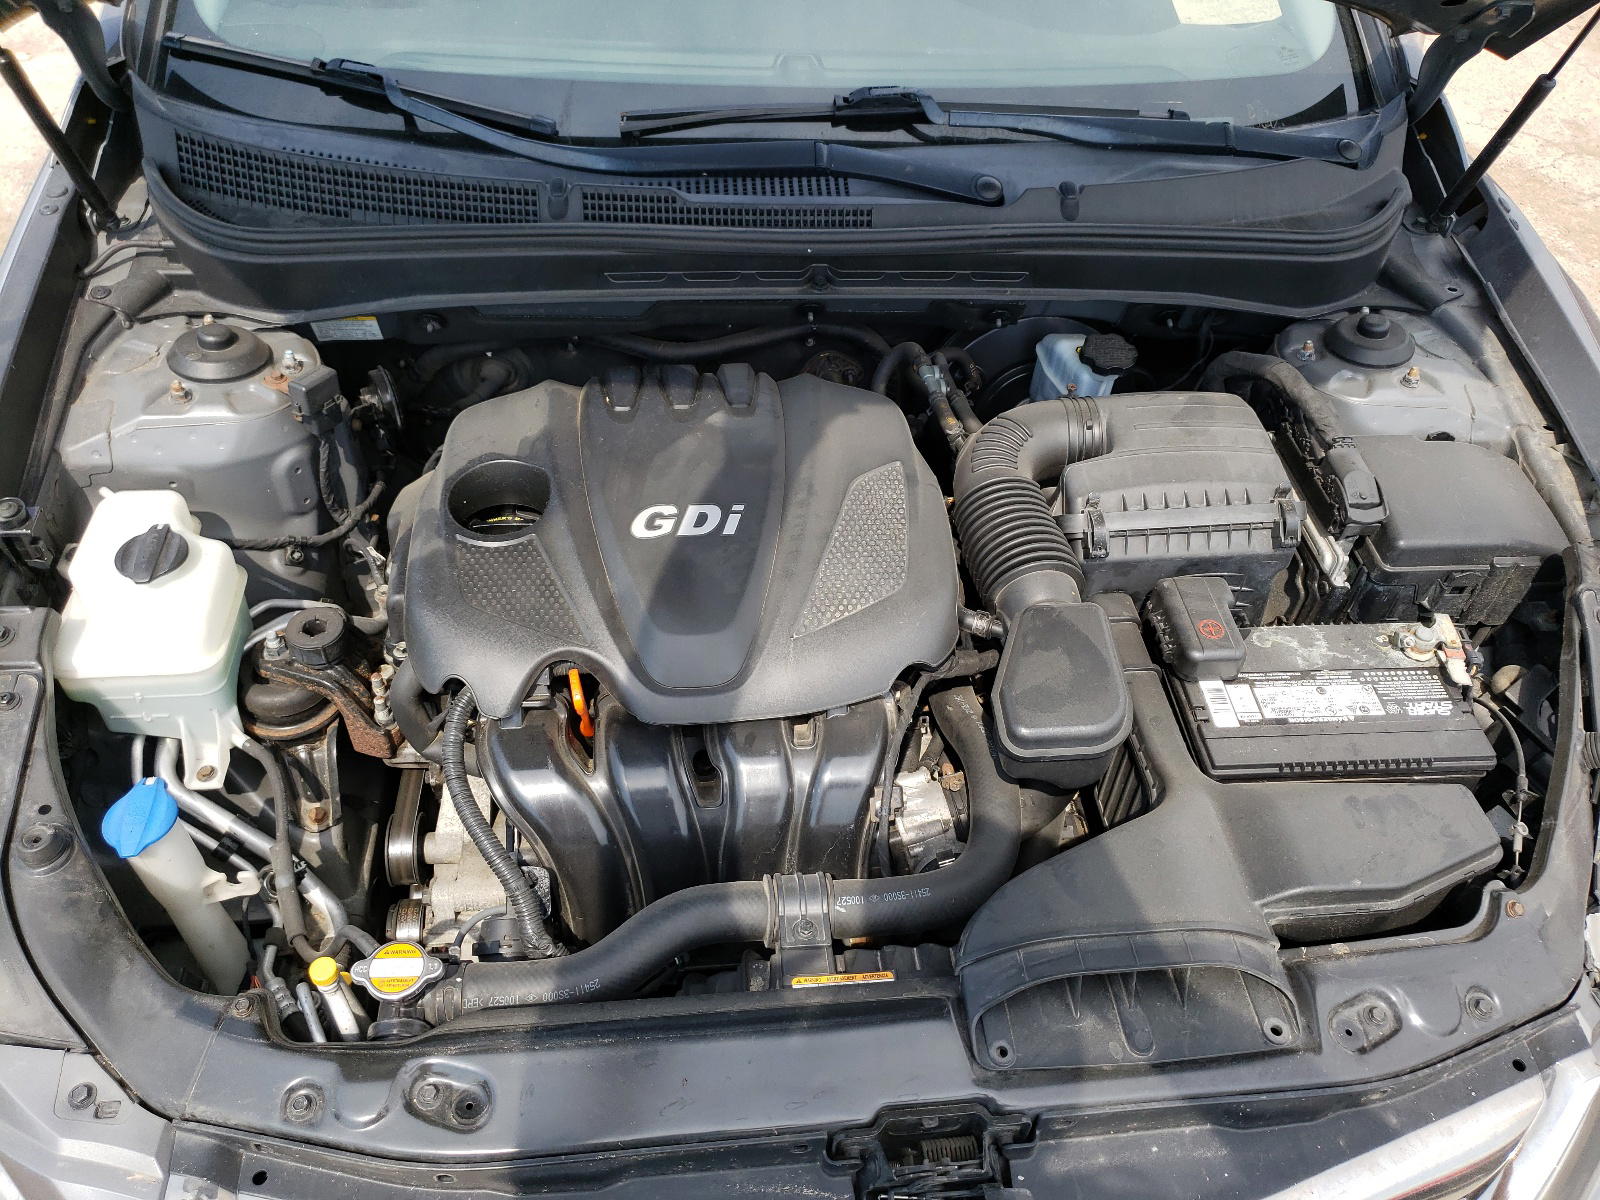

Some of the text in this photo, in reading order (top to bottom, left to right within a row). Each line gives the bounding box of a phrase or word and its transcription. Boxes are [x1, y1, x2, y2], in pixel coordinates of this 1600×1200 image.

[630, 504, 745, 539] GDi
[1408, 707, 1452, 716] SUPER
[836, 895, 864, 906] 100527
[542, 978, 601, 1002] 25411-3S000
[488, 994, 520, 1007] 100527
